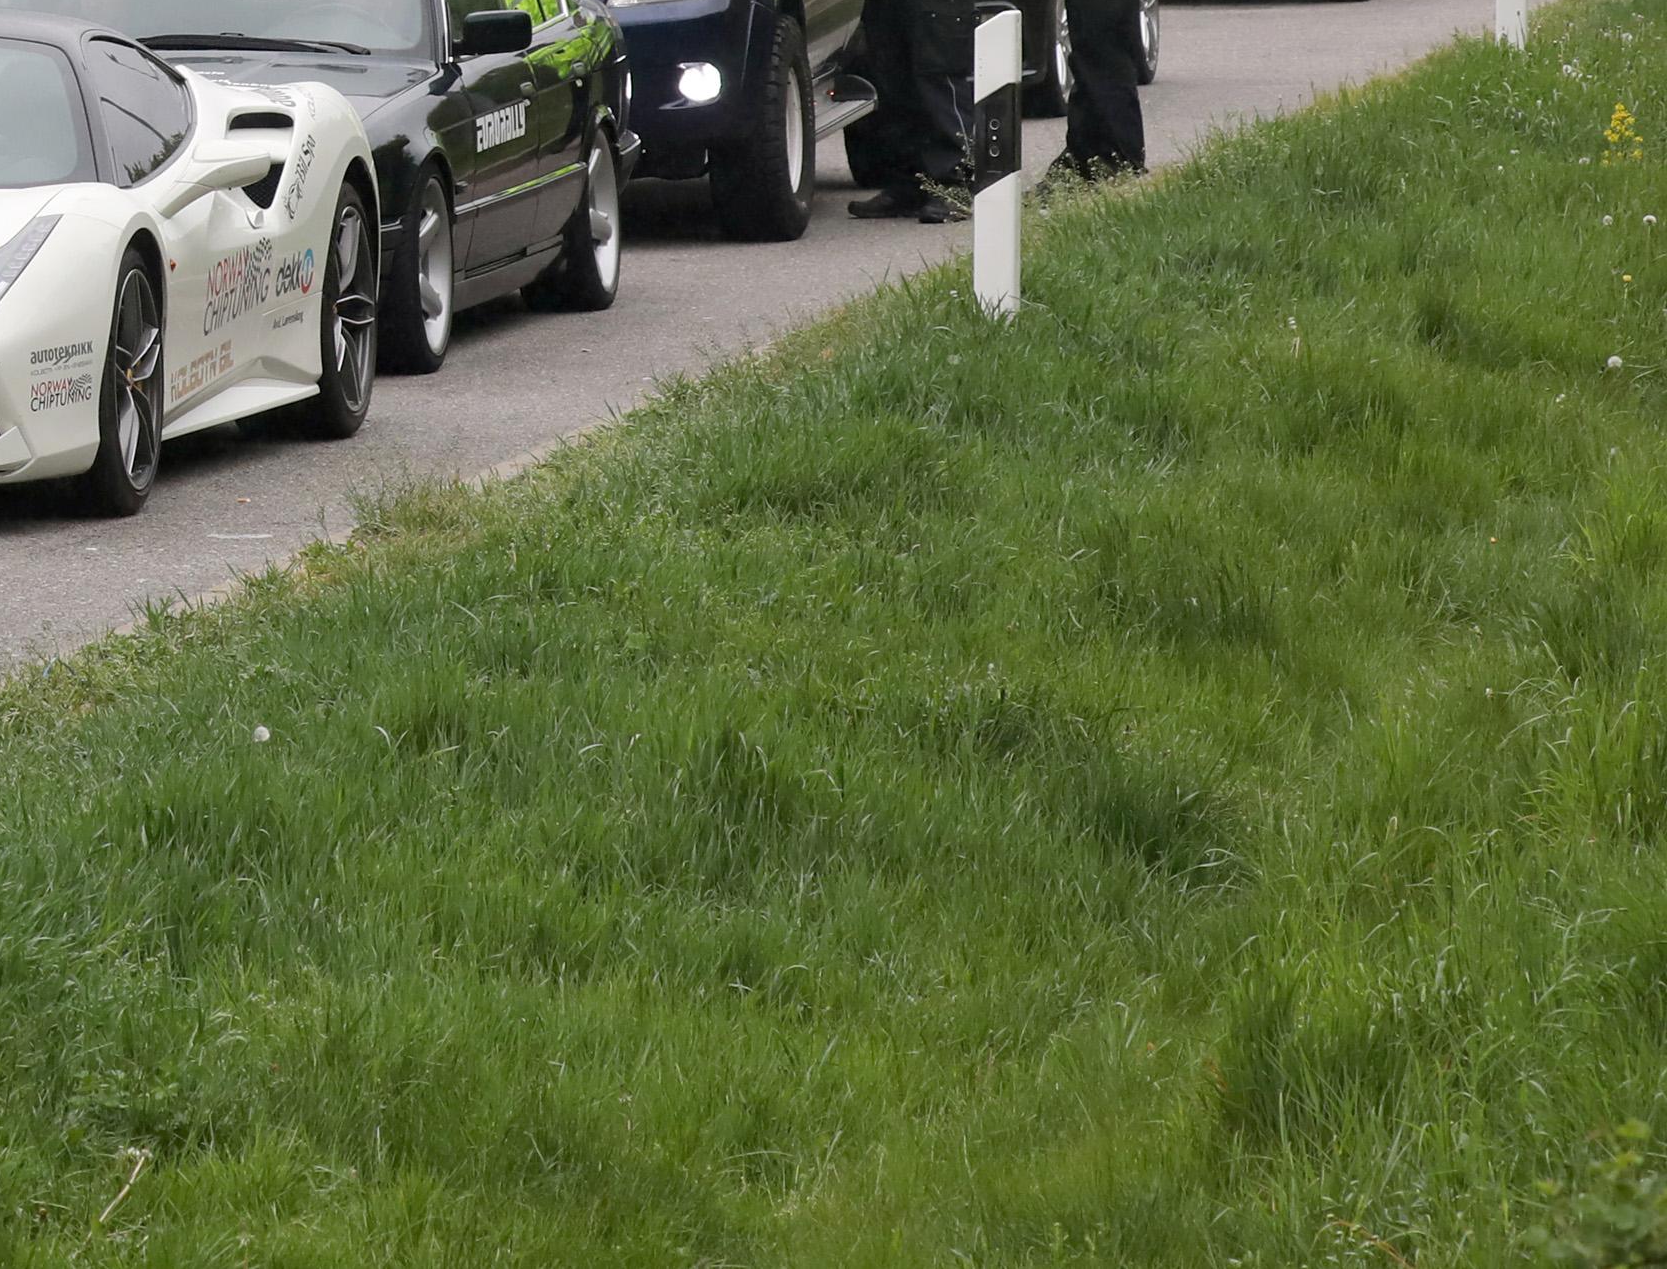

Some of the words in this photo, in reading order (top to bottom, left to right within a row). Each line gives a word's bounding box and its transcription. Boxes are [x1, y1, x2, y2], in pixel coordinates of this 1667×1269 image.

[475, 103, 526, 153] EURORALLY
[203, 268, 271, 336] CHIPTUNING
[30, 377, 73, 399] NORWAY
[30, 385, 93, 413] CHIPTUNING
